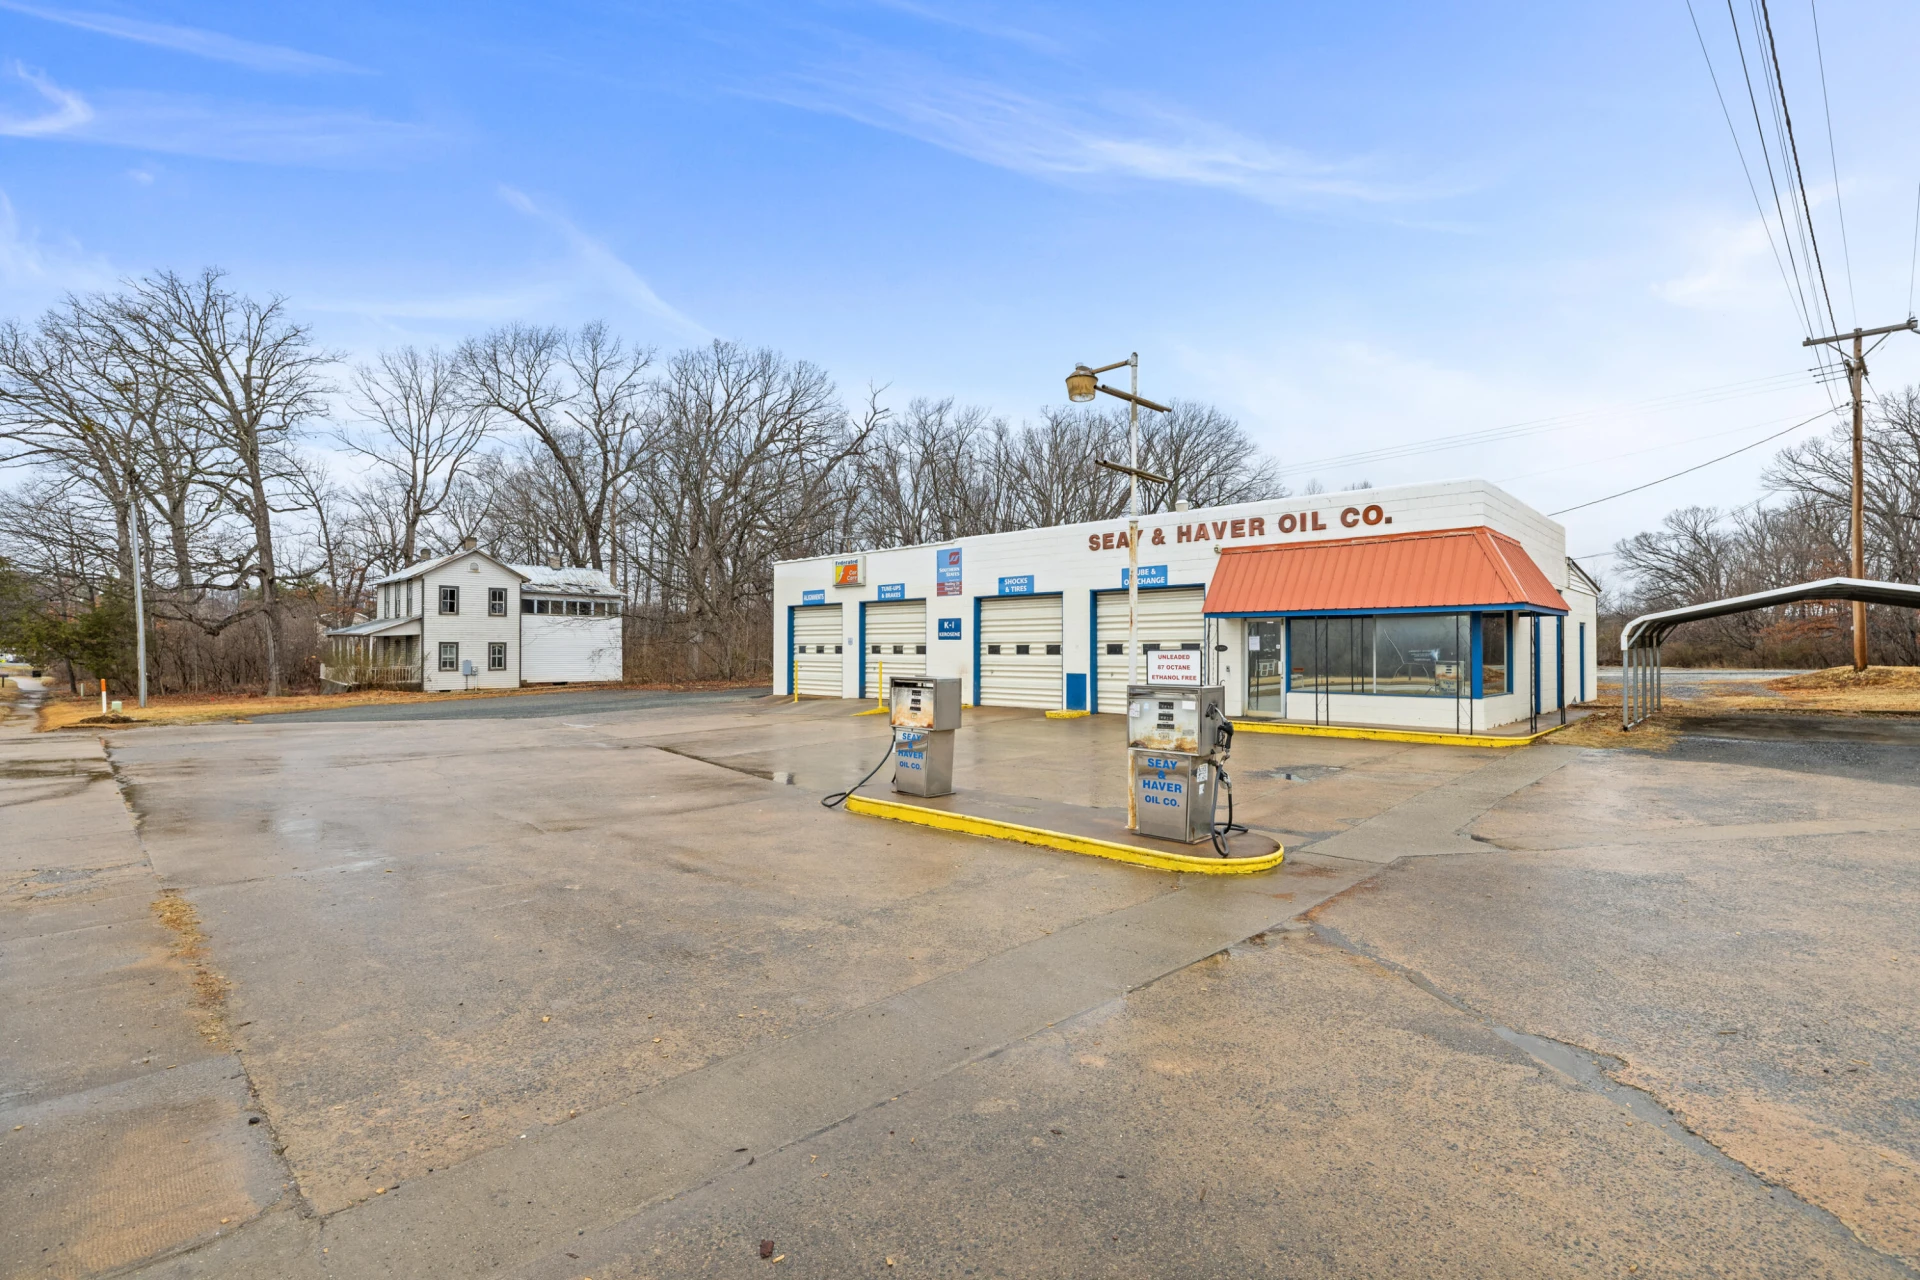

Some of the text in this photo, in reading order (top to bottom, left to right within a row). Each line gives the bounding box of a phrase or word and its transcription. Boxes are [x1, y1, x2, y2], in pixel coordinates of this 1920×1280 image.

[1151, 528, 1166, 546] &
[1177, 517, 1265, 543] HAVER
[1278, 511, 1327, 533] OIL
[1340, 504, 1393, 528] CO.
[1004, 577, 1028, 585] SHOCKS
[1137, 576, 1166, 585] CHANGE
[1011, 585, 1027, 593] TIRES
[898, 750, 923, 759] HAVER
[910, 762, 922, 770] CO.
[1148, 758, 1177, 770] SEAY
[1158, 770, 1166, 779] &
[1143, 780, 1182, 793] HAVER
[1145, 795, 1180, 807] OIL CO.
